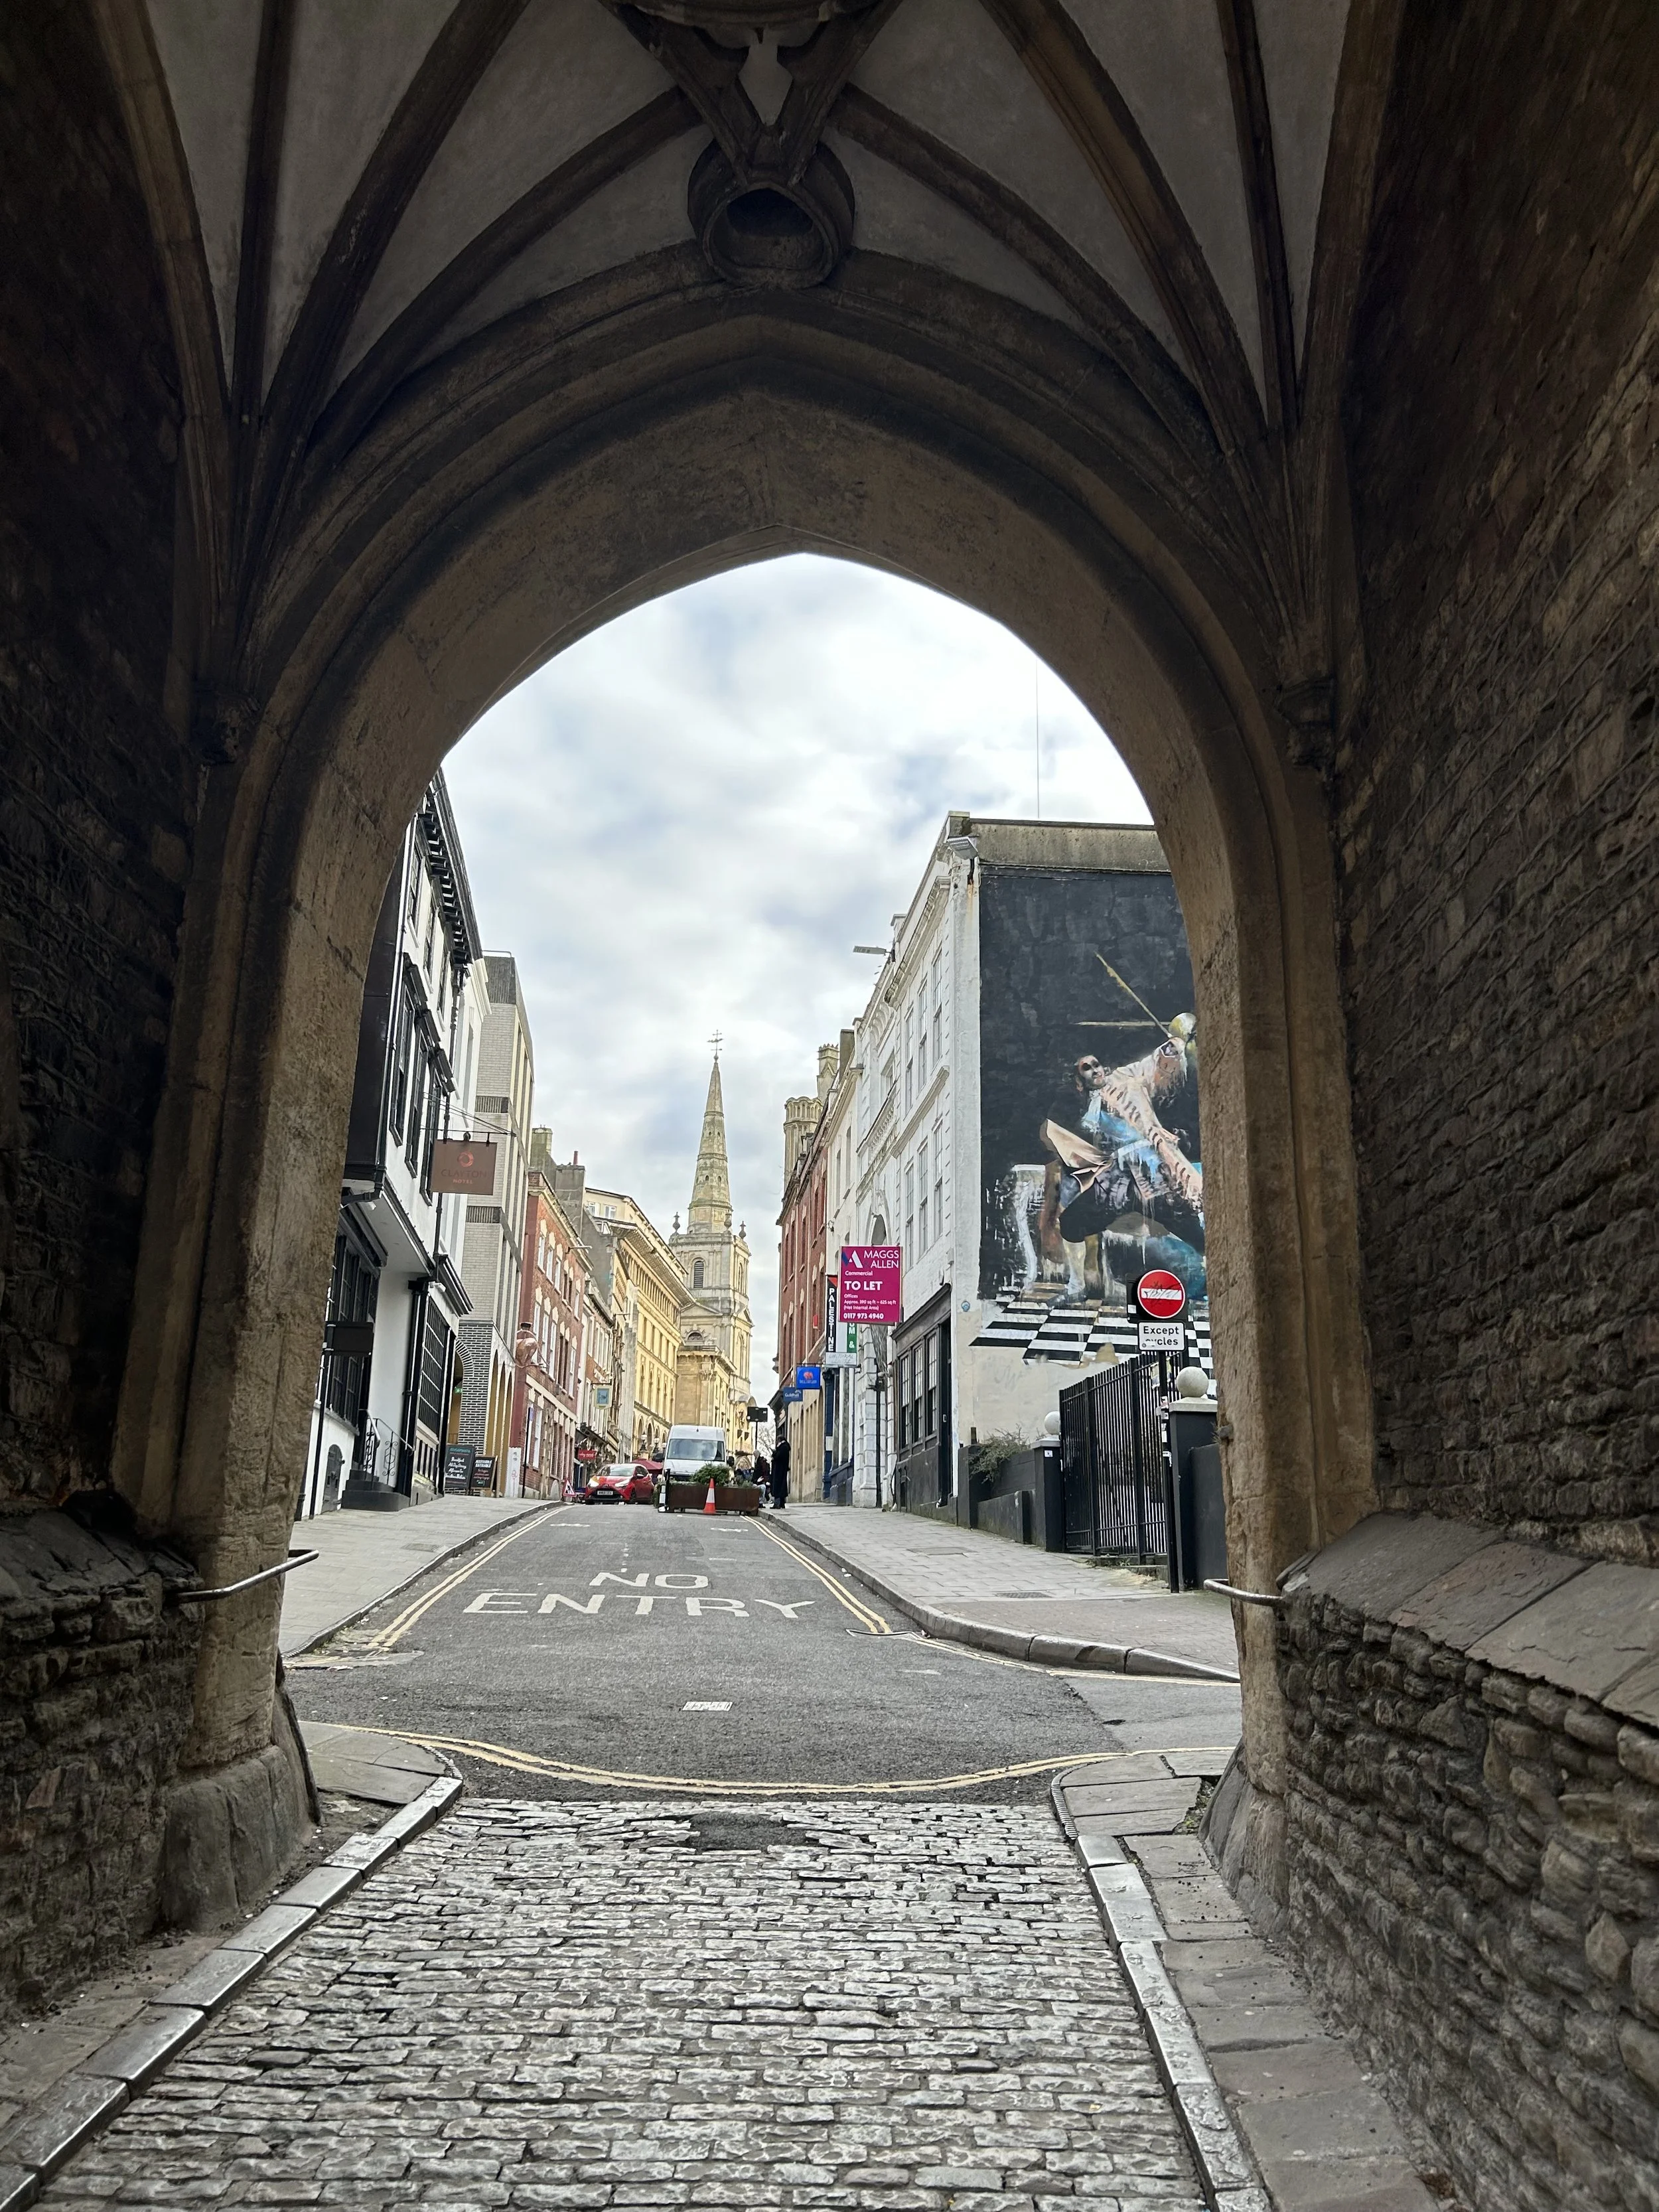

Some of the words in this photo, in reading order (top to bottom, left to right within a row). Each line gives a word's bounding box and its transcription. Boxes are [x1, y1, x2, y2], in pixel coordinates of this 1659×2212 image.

[441, 1169, 487, 1178] CLAYTON
[864, 1250, 899, 1259] MAGGS
[871, 1260, 899, 1268] ALLEN
[844, 1281, 861, 1290] TO
[863, 1281, 883, 1291] LET
[1143, 1326, 1179, 1335] Except
[589, 1572, 709, 1589] NO
[463, 1593, 816, 1618] ENTRY
